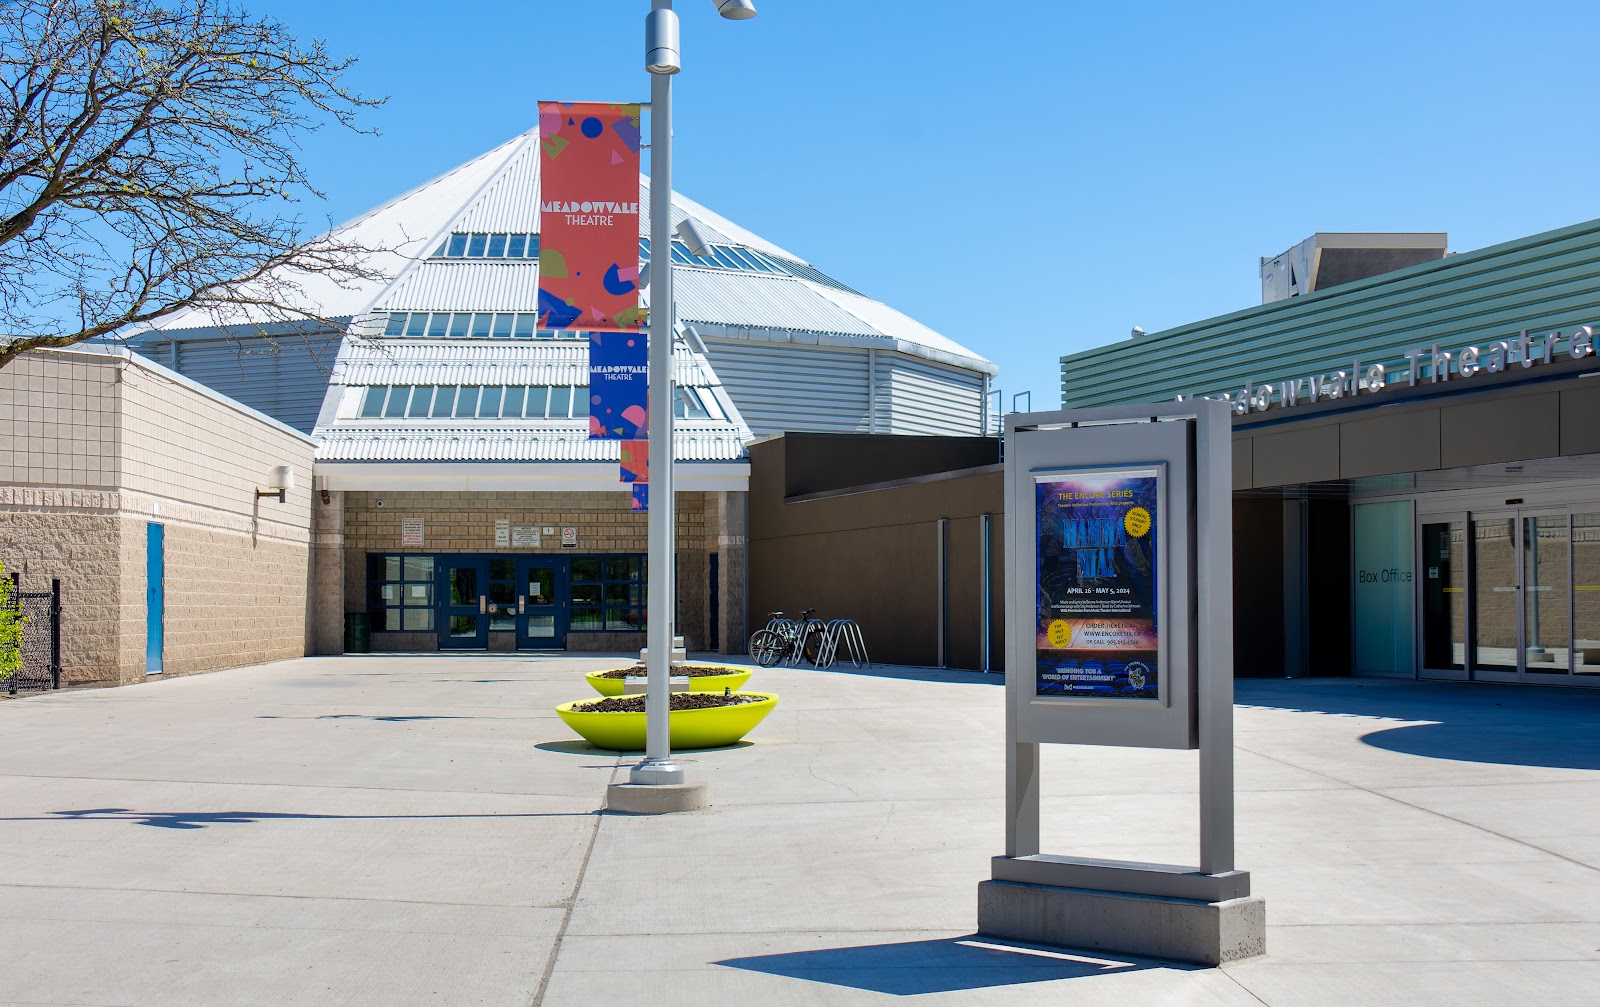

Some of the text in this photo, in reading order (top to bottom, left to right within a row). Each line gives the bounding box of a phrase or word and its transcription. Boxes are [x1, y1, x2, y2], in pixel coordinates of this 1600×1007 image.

[541, 200, 638, 214] MEADOWVALE
[565, 214, 613, 226] THEATRE
[1404, 326, 1592, 387] Theatre
[590, 365, 647, 374] MEADOWVALE
[604, 373, 633, 381] THEATRE
[1058, 489, 1133, 500] THE ENCORE SERIES
[1359, 568, 1412, 583] Box Office
